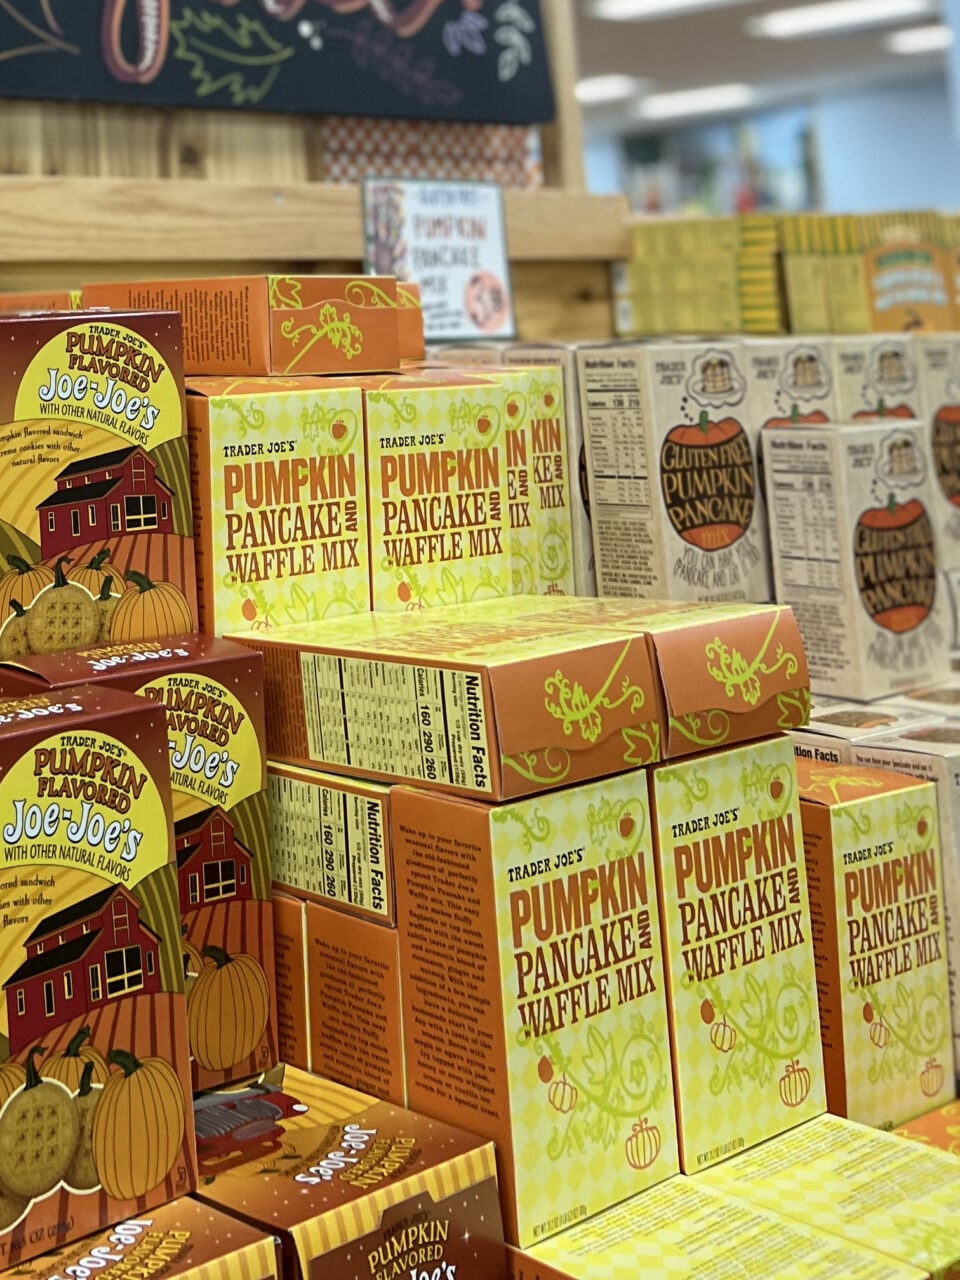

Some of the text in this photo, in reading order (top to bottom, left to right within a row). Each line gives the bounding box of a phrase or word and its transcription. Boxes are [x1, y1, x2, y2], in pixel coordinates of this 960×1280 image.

[89, 325, 144, 349] TRADER JOE'S
[66, 331, 165, 384] PUMPKIN
[68, 354, 150, 393] FLAVORED
[38, 368, 160, 431] Joe-Joe's
[223, 438, 295, 457] TRADER JOE'S
[379, 432, 445, 449] TRADER JOE'S
[662, 436, 752, 470] GLUTEN FREE
[224, 453, 356, 510] PUMPKIN
[380, 447, 500, 498] PUMPKIN
[553, 455, 562, 480] AND
[663, 469, 754, 503] PUMPKIN
[346, 500, 358, 532] AND
[382, 491, 487, 536] PANCAKE
[490, 491, 501, 521] AND
[540, 485, 565, 510] MIX
[668, 497, 754, 530] PANCAKE
[225, 501, 342, 550] PANCAKE
[226, 538, 360, 583] WAFFLE MIX
[384, 527, 504, 568] WAFFLE MIX
[168, 678, 224, 698] TRADER JOE'S
[144, 687, 244, 734] PUMPKIN
[167, 712, 229, 747] AVORED
[417, 668, 436, 779] Calories 160 290 260
[60, 736, 125, 758] TRADER JOE'S
[465, 675, 487, 787] Nutrition Facts
[33, 748, 148, 801] PUMPKIN
[168, 734, 239, 788] -Joe's
[815, 748, 838, 762] Facts
[37, 775, 131, 814] FLAVORED
[171, 772, 228, 804] ATURAL FLAVORS
[2, 799, 143, 863] Joe-Joe's
[671, 808, 738, 837] TRADER JOE'S
[4, 844, 132, 882] WITH OTHER NATURAL FLAVORS
[367, 801, 384, 910] Nutrition Facts
[507, 847, 583, 882] TRADER JOE'S
[674, 813, 796, 899] PUMPKIN
[843, 842, 893, 865] TRADER JOE'S
[20, 875, 56, 889] sandwich
[510, 852, 648, 948] PUMPKIN
[788, 867, 801, 904] AND
[844, 849, 936, 916] PUMPKIN
[3, 915, 29, 928] flavors
[13, 898, 30, 910] with
[32, 895, 53, 908] other
[678, 871, 787, 946] PANCAKE
[928, 894, 939, 925] AND
[637, 910, 652, 949] AND
[848, 897, 928, 956] PANCAKE
[514, 915, 636, 999] PANCAKE
[682, 910, 805, 984] WAFFLE MIX
[849, 932, 942, 988] WAFFLE MIX
[518, 957, 657, 1039] WAFFLE MIX
[368, 1221, 450, 1273] PUMPKIN
